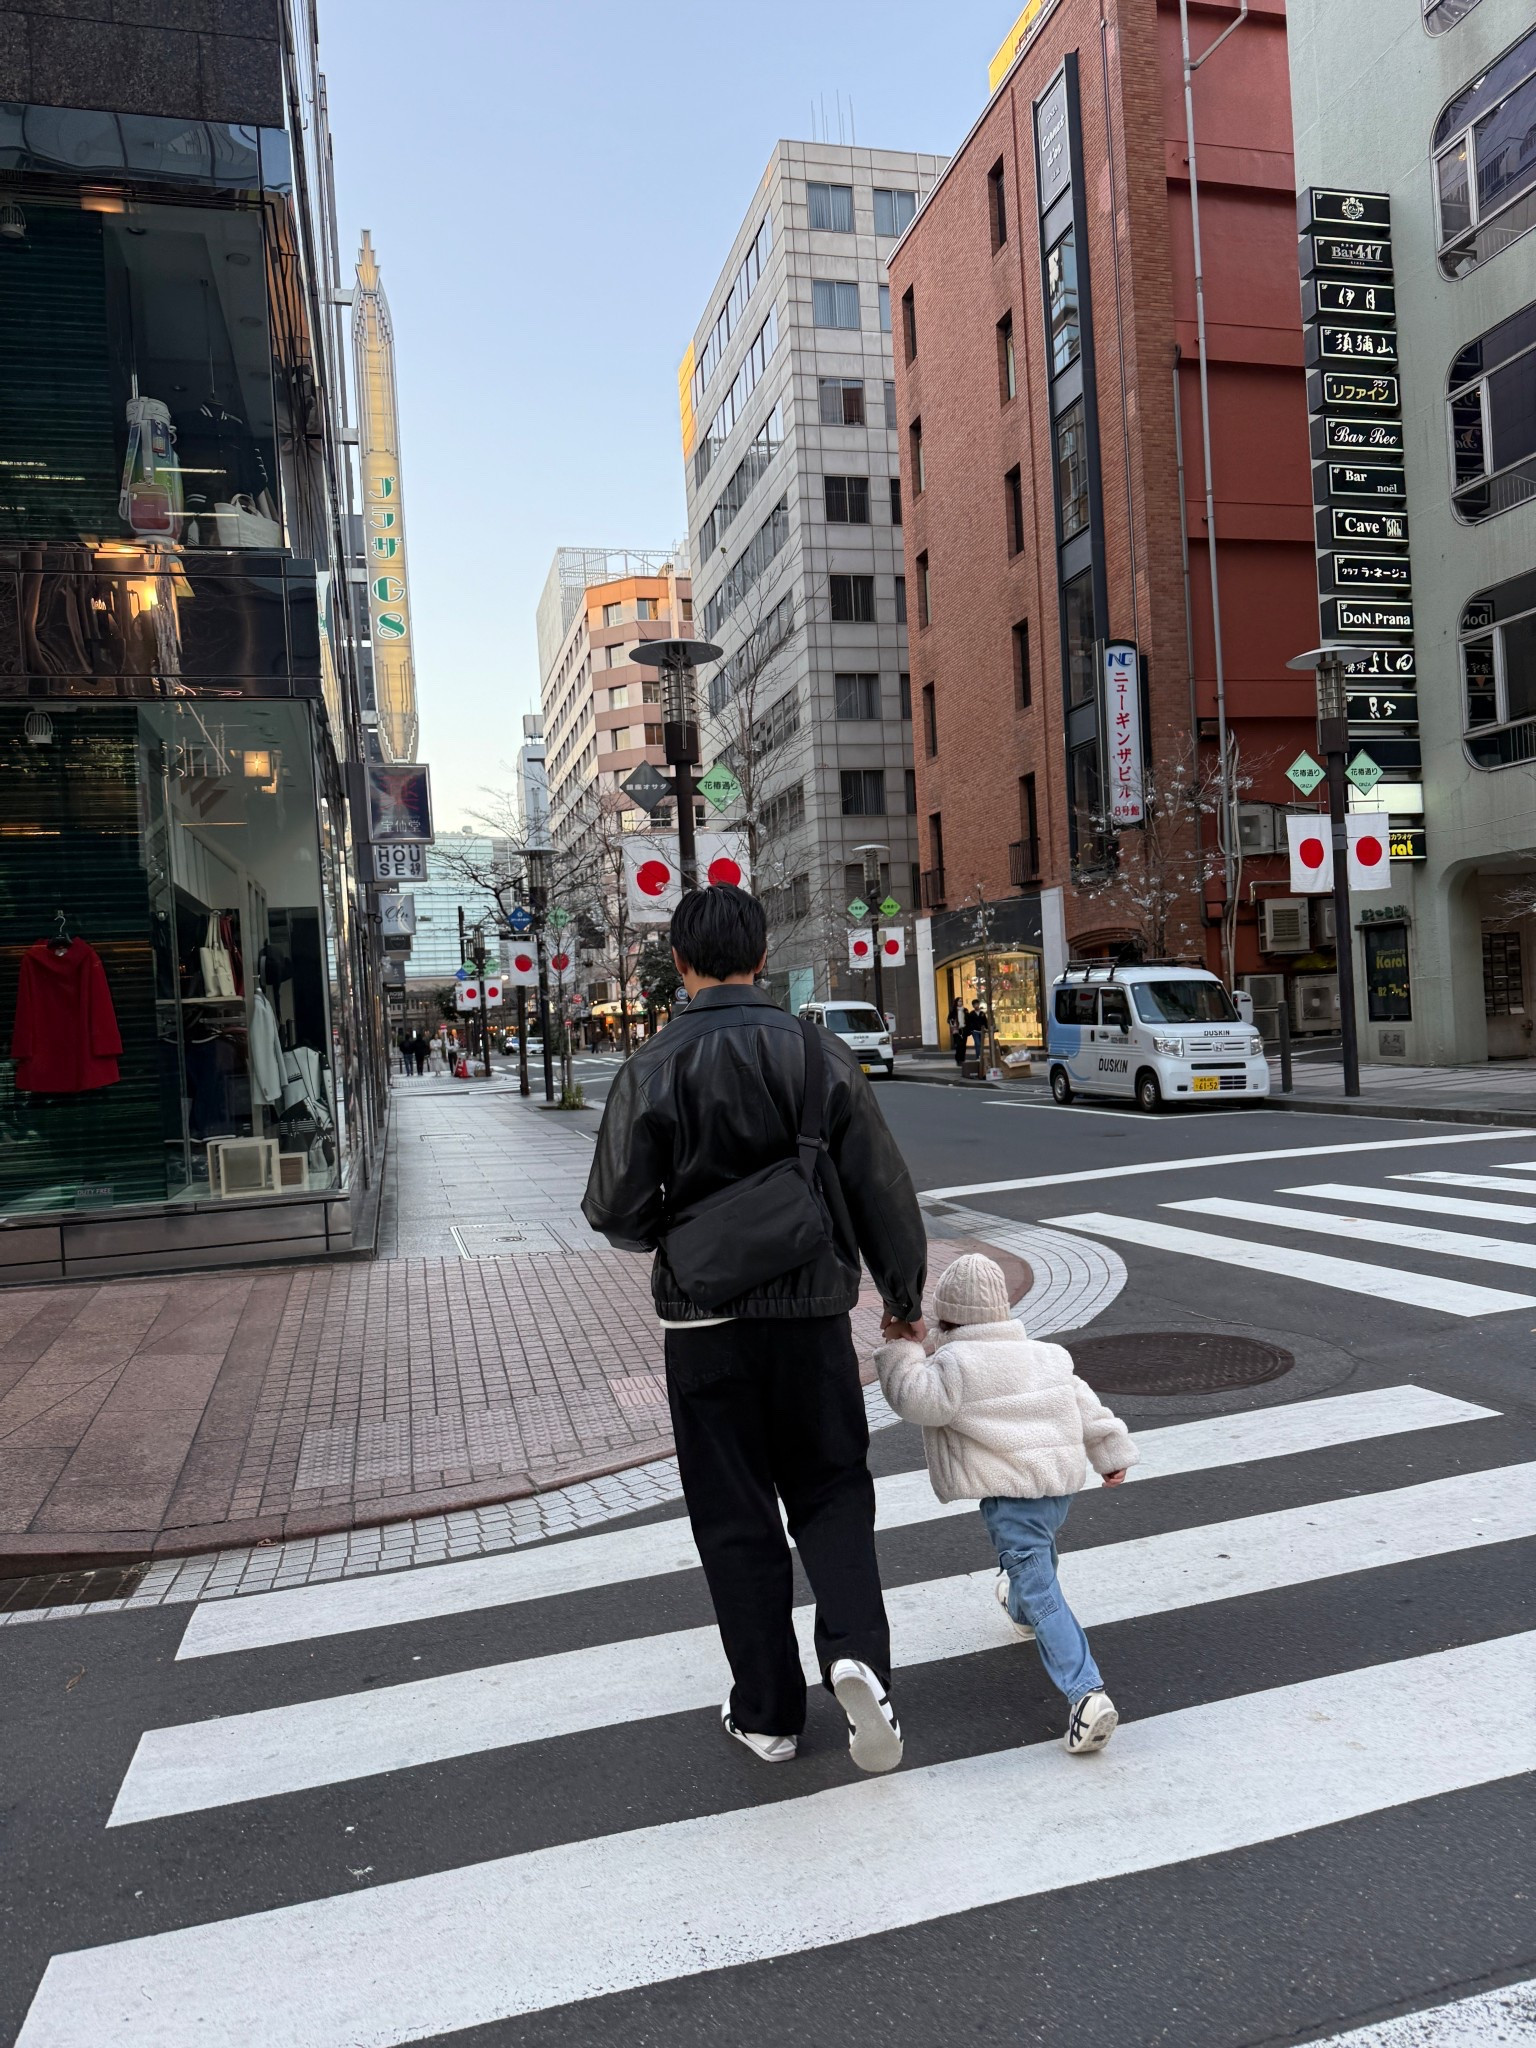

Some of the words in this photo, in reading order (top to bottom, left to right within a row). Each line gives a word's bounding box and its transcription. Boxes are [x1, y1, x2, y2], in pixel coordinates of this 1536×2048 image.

[1333, 384, 1389, 401] リファイン
[1334, 426, 1367, 443] Bar
[1344, 470, 1368, 482] Bar
[1344, 517, 1380, 534] Cave
[1361, 567, 1407, 578] ラ・ネージュ
[1113, 671, 1132, 800] ニューギンザビル
[1292, 768, 1321, 778] 花椿通り
[1350, 767, 1379, 777] 花椿通り
[1391, 840, 1413, 856] rat
[378, 849, 421, 863] HOU
[379, 863, 406, 876] SE
[1099, 1057, 1129, 1073] DUSKIN
